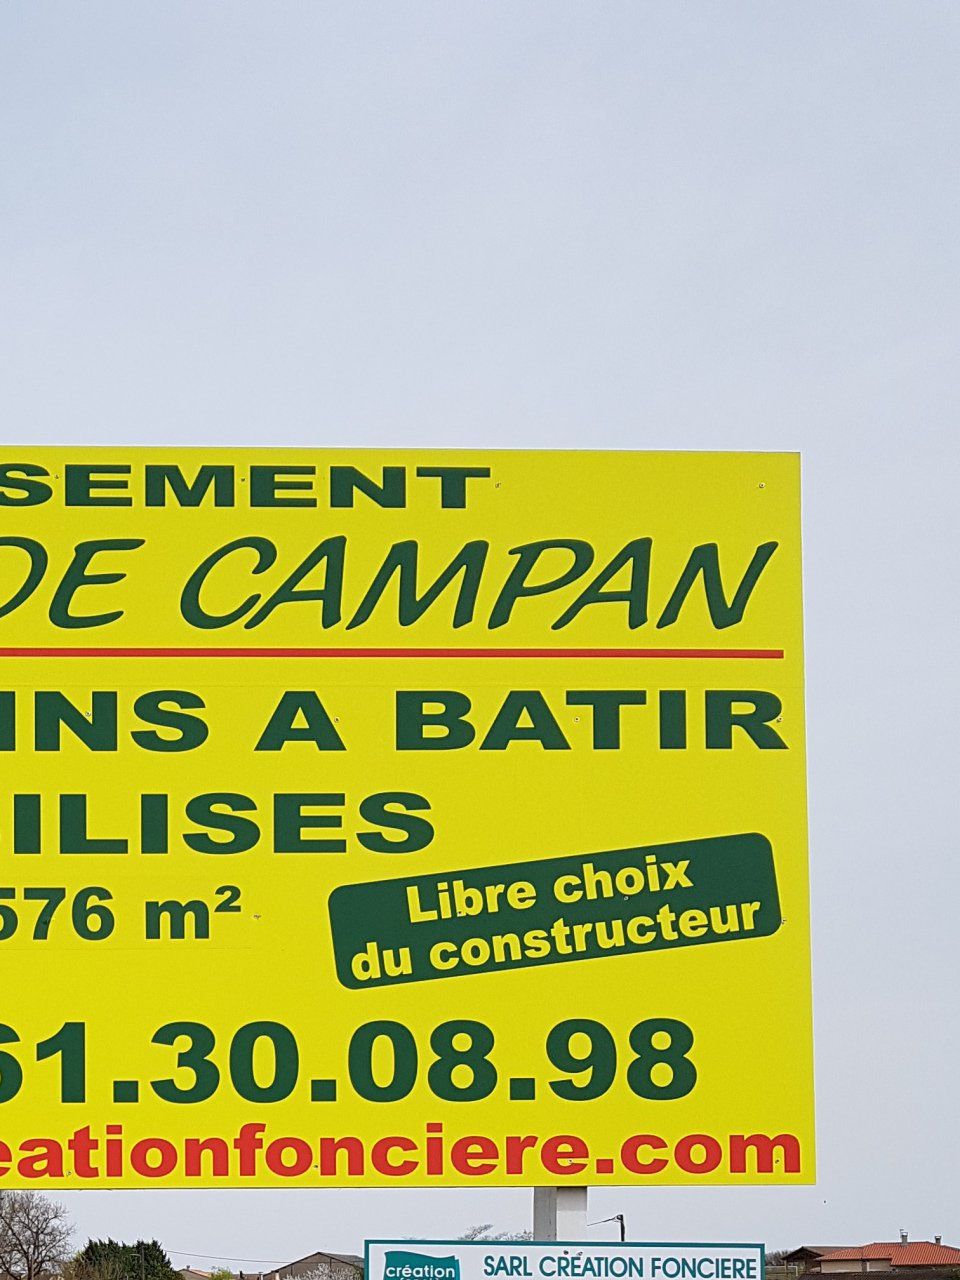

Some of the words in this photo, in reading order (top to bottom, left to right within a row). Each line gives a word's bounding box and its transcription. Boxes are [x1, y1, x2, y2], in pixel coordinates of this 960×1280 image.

[181, 536, 778, 630] CAMPAN
[254, 691, 346, 751] A
[396, 690, 788, 750] BATIR
[146, 886, 241, 939] m²
[406, 875, 536, 923] Libre
[552, 856, 692, 901] choix
[352, 942, 413, 984] du
[430, 896, 762, 972] constructeur
[385, 1264, 455, 1278] création
[483, 1255, 533, 1277] SARL
[539, 1255, 644, 1278] CREATION
[651, 1257, 757, 1279] FONCIERE
